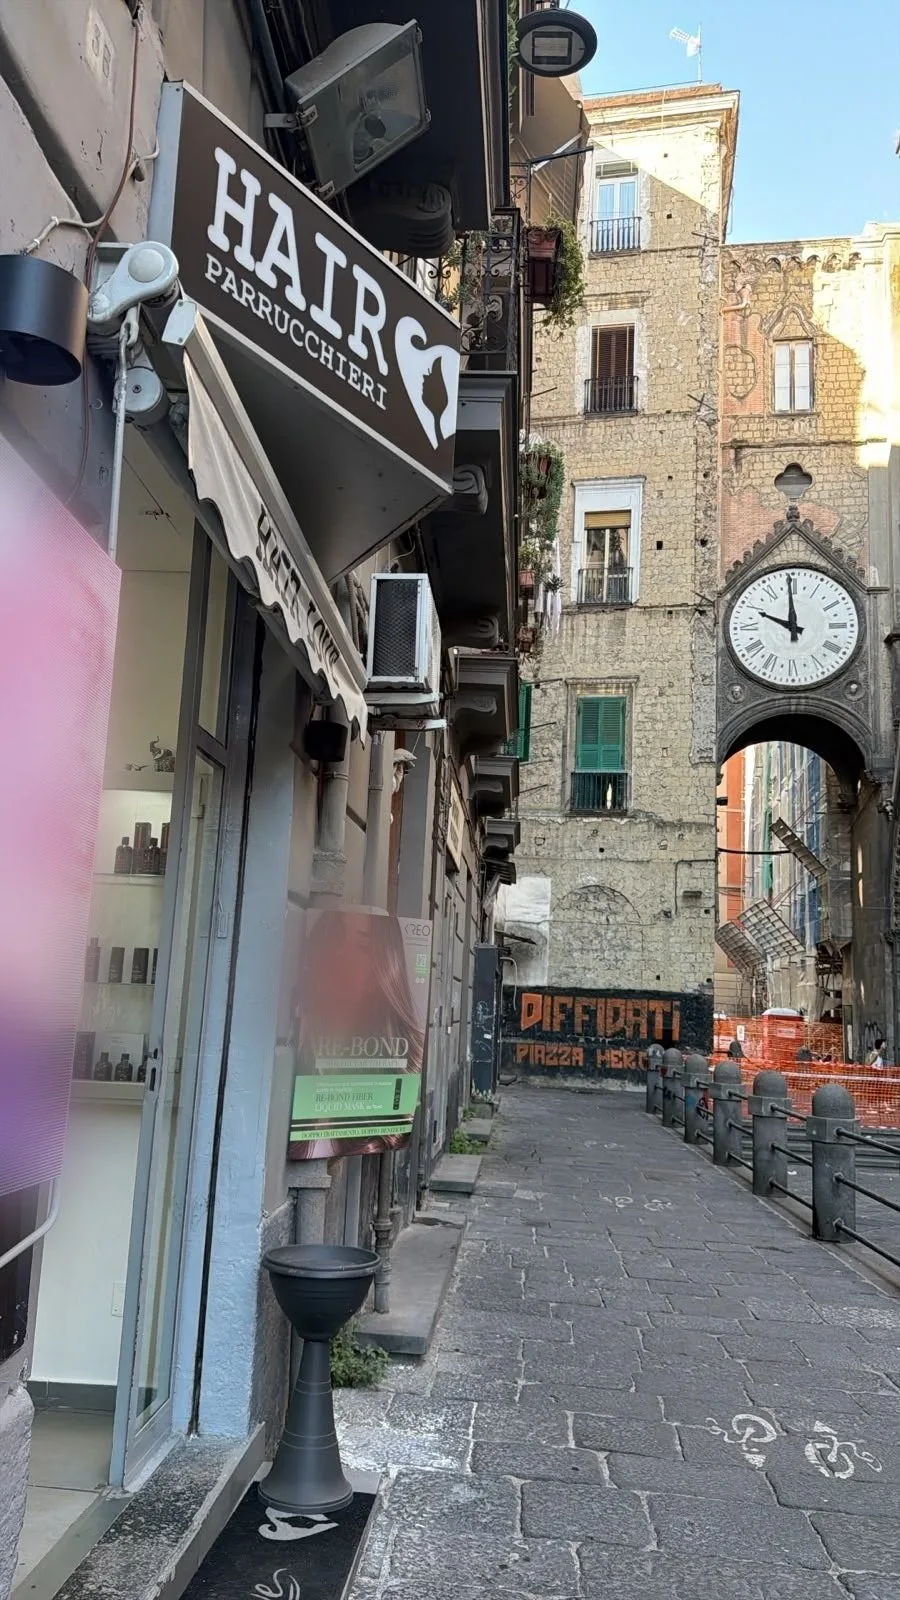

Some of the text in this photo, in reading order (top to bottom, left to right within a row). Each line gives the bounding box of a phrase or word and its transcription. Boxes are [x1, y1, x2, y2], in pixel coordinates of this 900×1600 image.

[207, 146, 389, 377] HAIR
[204, 252, 388, 411] PARRUCCHIERI
[317, 1036, 409, 1057] RE-BOND
[516, 1043, 648, 1071] PIAZZA MERC
